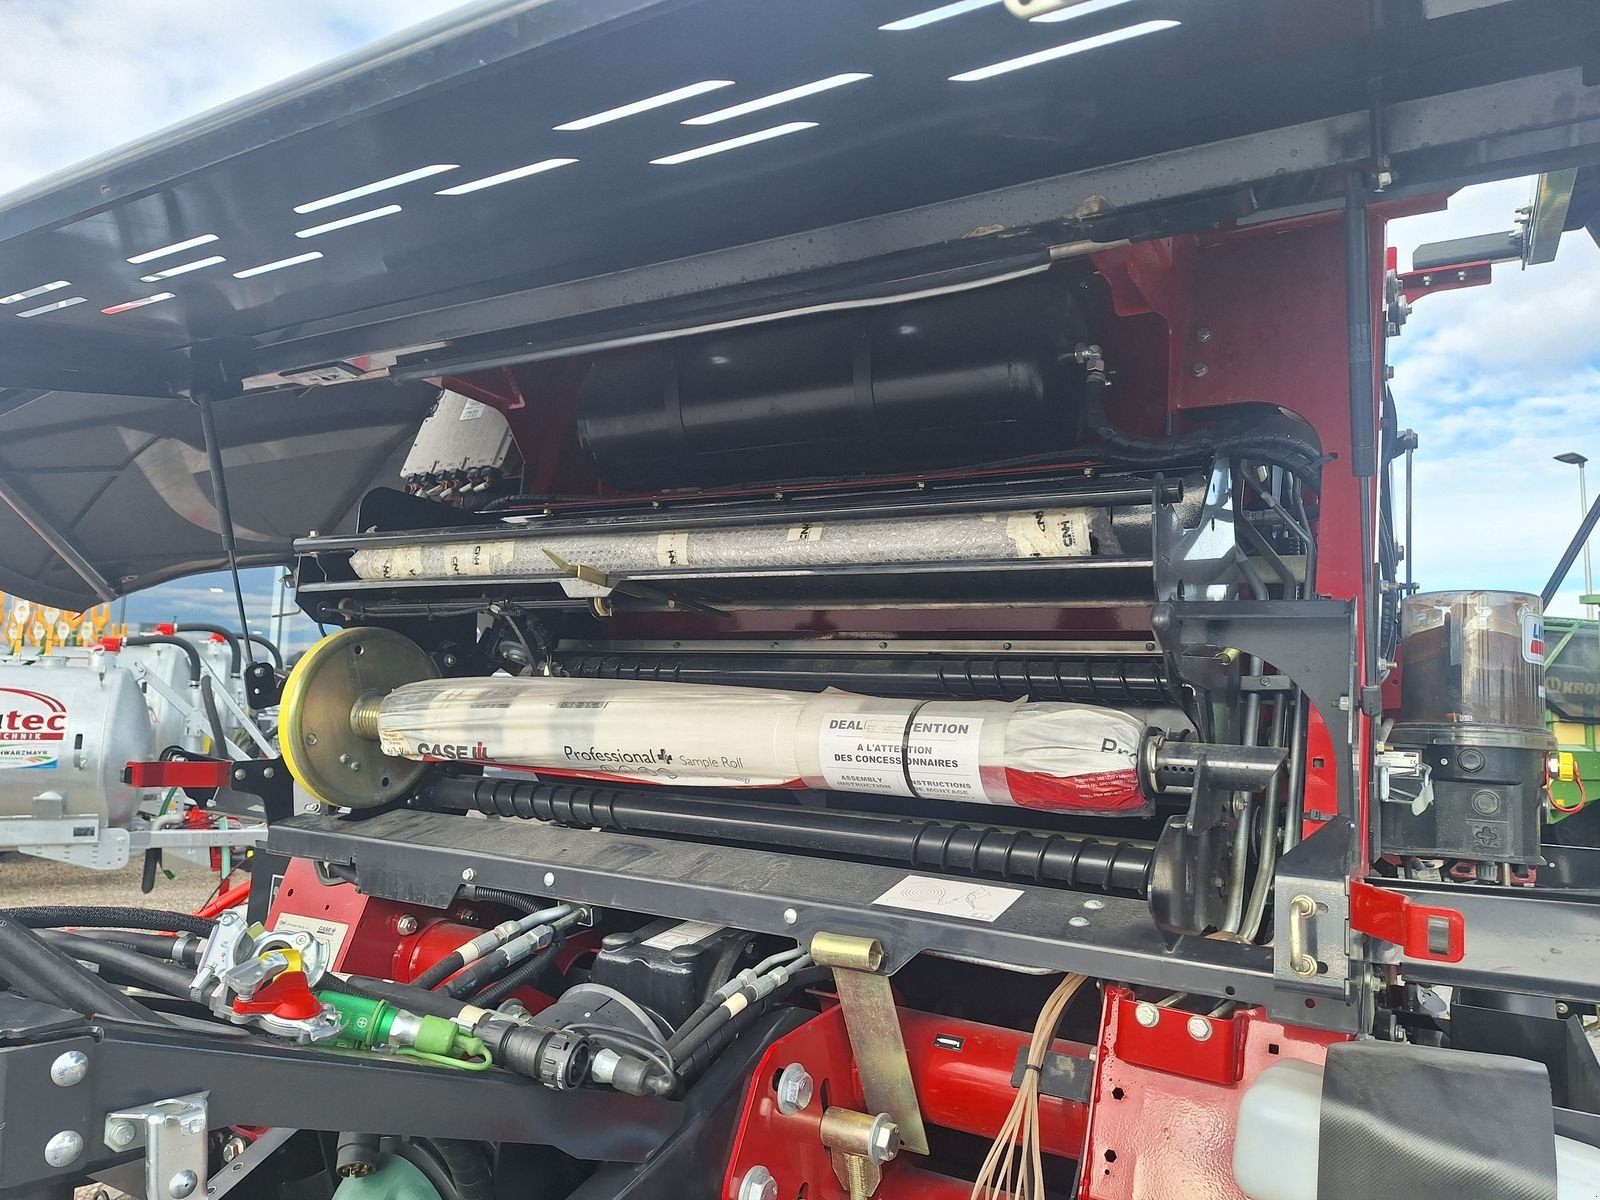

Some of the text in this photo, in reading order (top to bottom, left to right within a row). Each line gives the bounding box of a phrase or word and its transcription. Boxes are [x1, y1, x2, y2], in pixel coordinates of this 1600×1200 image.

[1060, 520, 1073, 547] CNH
[0, 711, 66, 730] tec
[829, 720, 866, 730] DEAL
[911, 722, 969, 734] ENTION
[417, 743, 469, 760] CASE
[857, 743, 864, 752] A
[563, 745, 745, 770] Professional Sample Roll
[834, 753, 959, 768] DES CONCESSONNAIRES
[841, 775, 883, 783] ASSEMBLY
[909, 780, 972, 789] NSTRUCTIONS
